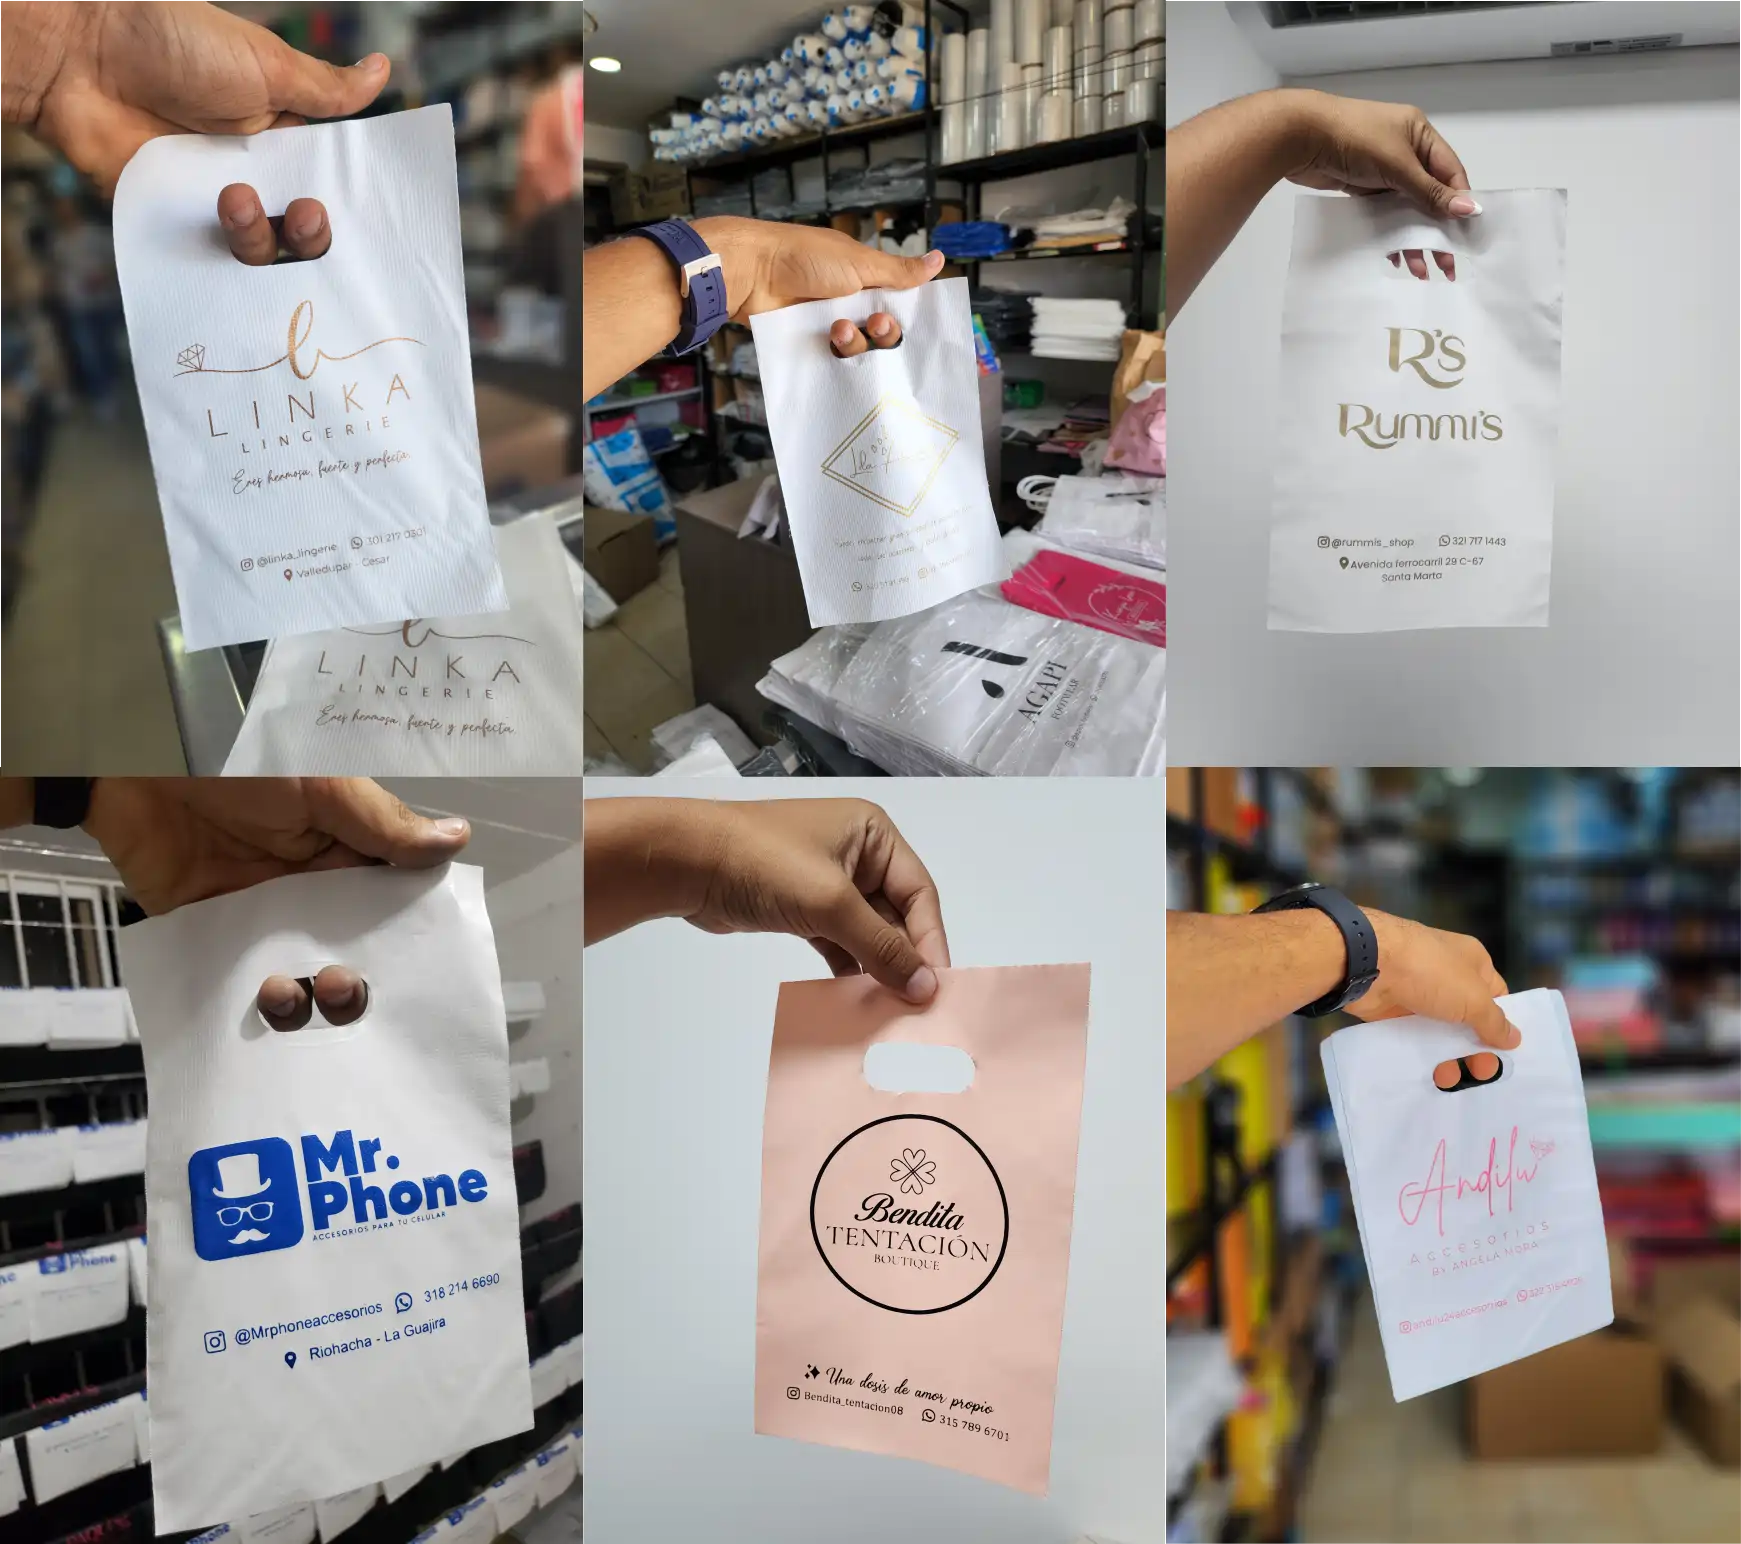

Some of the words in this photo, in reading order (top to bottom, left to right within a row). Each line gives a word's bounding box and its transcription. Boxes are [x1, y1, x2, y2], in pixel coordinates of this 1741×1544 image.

[1384, 326, 1467, 390] R's
[207, 373, 411, 438] LINKA
[241, 415, 391, 453] LINGERIE
[232, 468, 263, 495] Eres
[318, 460, 349, 478] fuerte
[354, 461, 363, 474] y
[366, 536, 384, 546] 301
[385, 532, 401, 543] 217
[1331, 537, 1415, 549] @rummis_shop
[1452, 537, 1467, 546] 321
[1469, 537, 1483, 546] 717
[1485, 536, 1507, 547] 1443
[257, 542, 338, 568] @linka_lingerie
[296, 561, 352, 578] Valledupar
[362, 554, 391, 567] Cesar
[1350, 560, 1393, 570] Avenida
[1395, 557, 1443, 568] ferrocarril
[1445, 557, 1458, 566] 29
[1459, 556, 1484, 566] C-67
[1381, 573, 1411, 583] Santa
[1413, 572, 1443, 581] Marta
[317, 651, 521, 684] LINKA
[338, 683, 495, 700] LINGERIE
[1017, 660, 1068, 725] AGAPI
[1051, 678, 1080, 721] FOOTWEAR
[315, 704, 347, 726] Eres
[407, 713, 443, 730] fuerte
[447, 722, 457, 735] y
[300, 1129, 400, 1184] Mr.
[307, 1168, 488, 1231] Phone
[854, 1192, 965, 1231] Bendita
[312, 1226, 369, 1242] ACCESORIOS
[372, 1221, 394, 1231] PARA
[397, 1218, 408, 1226] TU
[411, 1211, 446, 1224] CELULAR
[826, 1225, 991, 1263] TENTACIÓN
[1452, 1251, 1501, 1271] ANGELA
[1504, 1240, 1539, 1256] MORA
[873, 1253, 941, 1272] BOUTIQUE
[423, 1287, 446, 1303] 318
[448, 1280, 469, 1297] 214
[471, 1272, 501, 1290] 6690
[234, 1301, 383, 1346] @Mrphoneaccesorios
[309, 1337, 373, 1361] Riohacha
[384, 1329, 401, 1343] La
[403, 1315, 447, 1338] Guajira
[803, 1391, 905, 1417] Bendita_tentacion08
[825, 1366, 855, 1387] Una
[859, 1372, 890, 1395] dosis
[893, 1378, 911, 1396] de
[914, 1390, 948, 1404] amor
[949, 1398, 995, 1416] propio
[939, 1414, 959, 1429] 315
[961, 1420, 982, 1434] 789
[983, 1426, 1011, 1443] 6701
